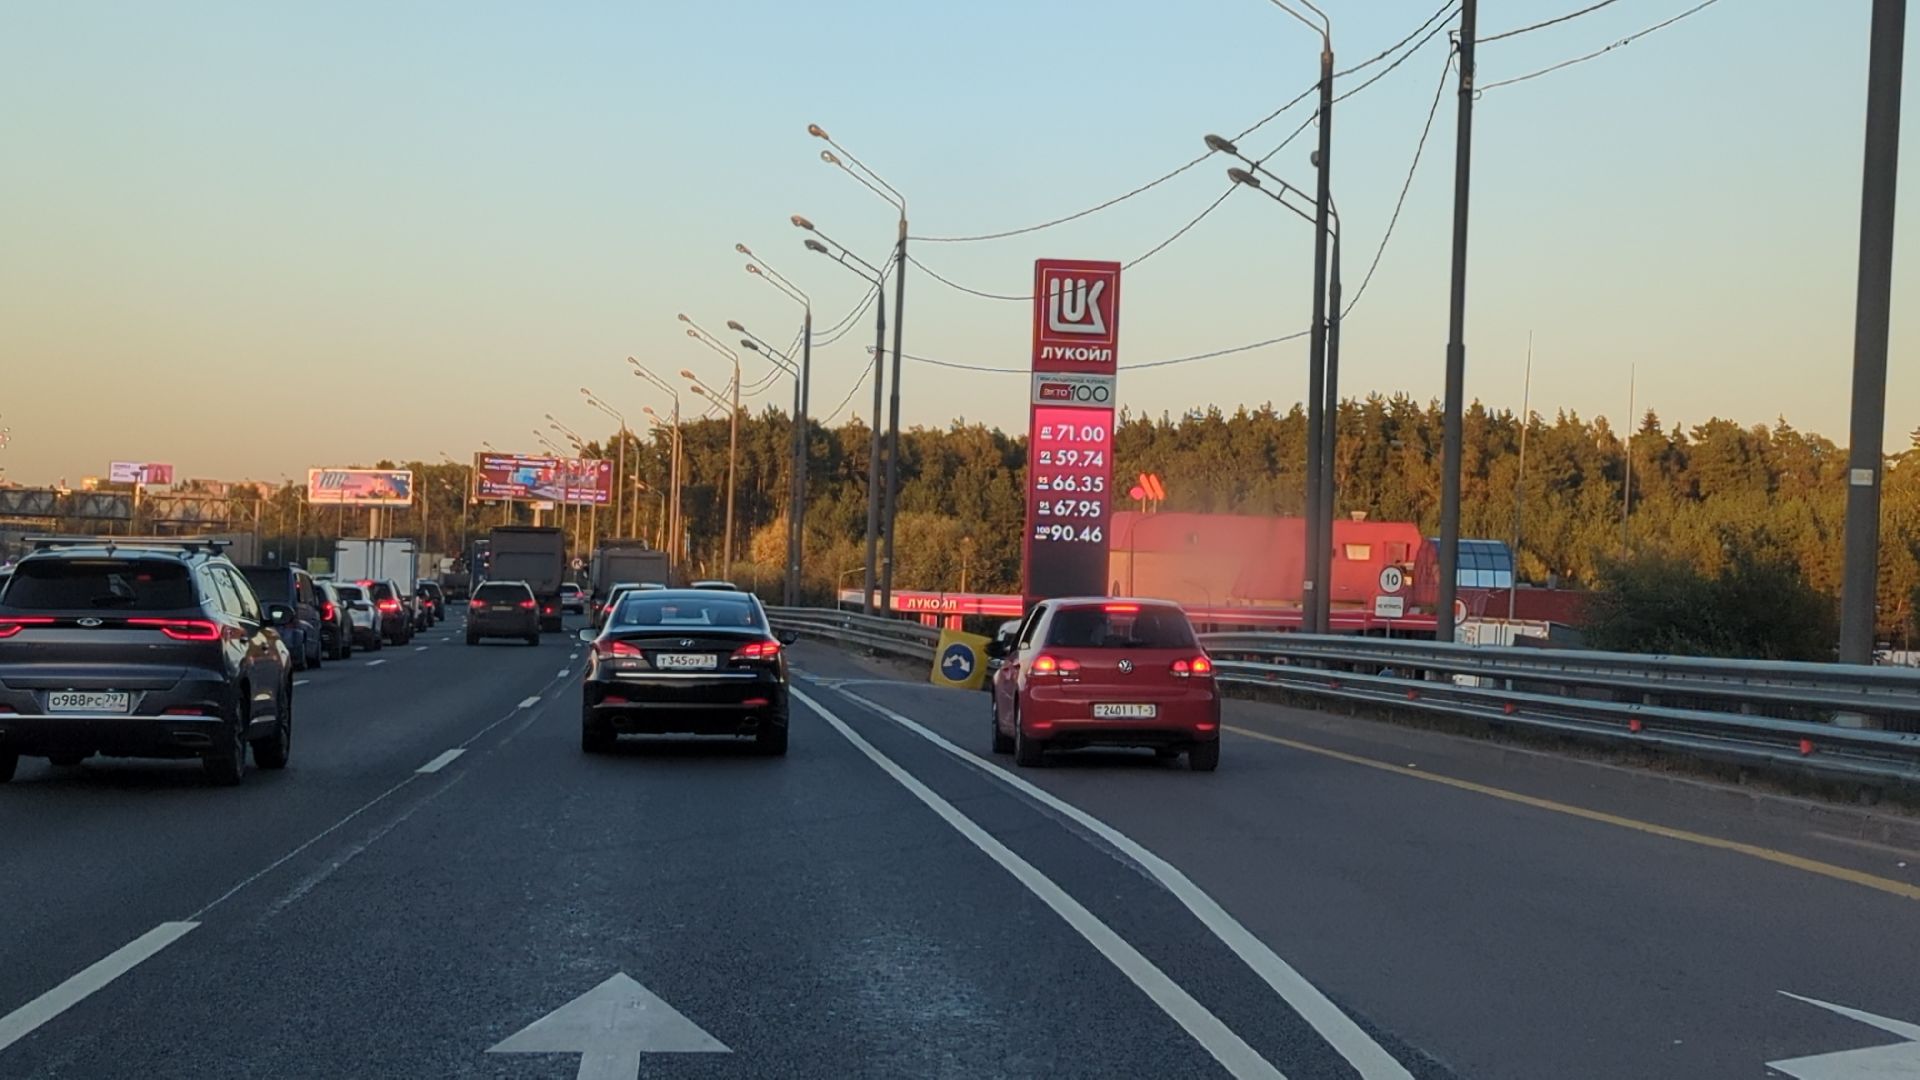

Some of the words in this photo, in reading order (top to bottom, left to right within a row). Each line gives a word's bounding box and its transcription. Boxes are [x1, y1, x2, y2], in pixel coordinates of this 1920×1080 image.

[1041, 346, 1112, 362] ЛУКОЙЛ
[1069, 384, 1109, 402] 100
[1056, 425, 1104, 442] 71.00
[1040, 451, 1051, 459] 92
[1055, 450, 1103, 467] 59.74
[1038, 476, 1048, 484] 95
[1052, 475, 1104, 492] 66.35
[1054, 500, 1100, 517] 67.95
[1036, 526, 1050, 534] 100
[1051, 525, 1102, 542] 90.46
[1386, 573, 1399, 586] 10
